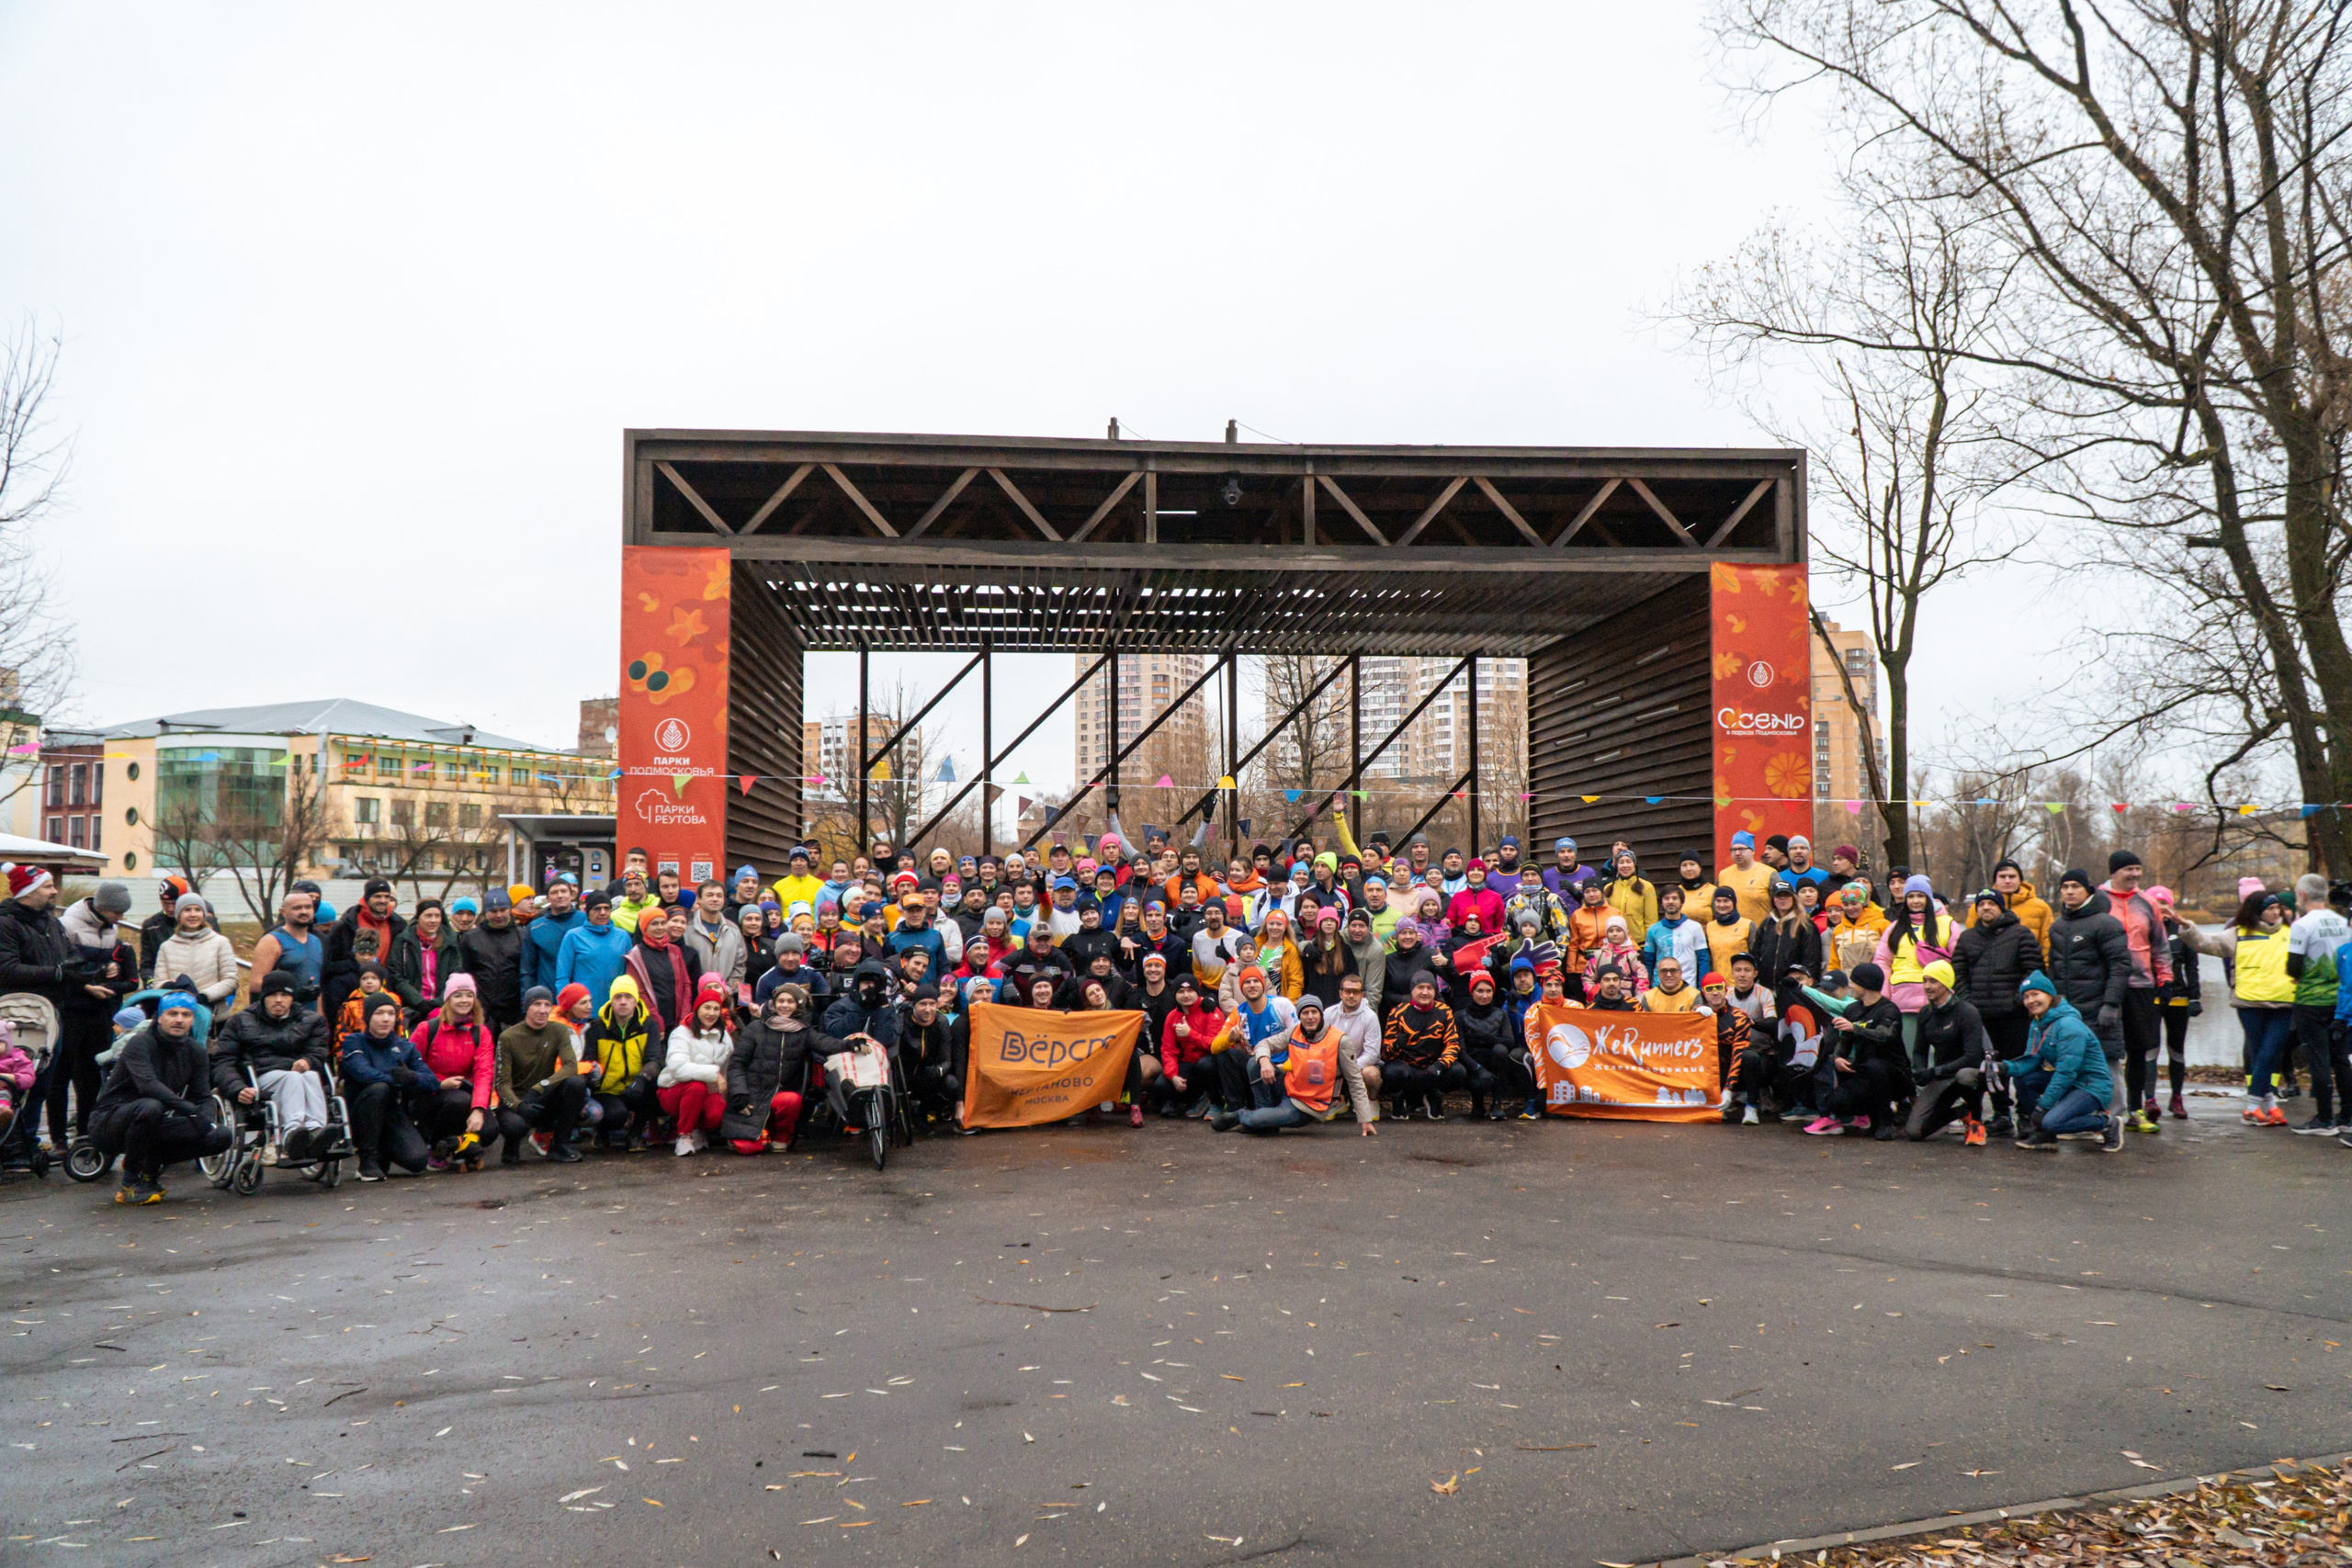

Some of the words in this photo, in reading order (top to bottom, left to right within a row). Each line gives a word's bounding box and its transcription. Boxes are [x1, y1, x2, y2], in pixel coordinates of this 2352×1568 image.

[653, 757, 690, 765] ПАРКИ
[629, 766, 714, 776] ПОДМОСКОВЬЯ
[654, 805, 695, 815] ПАРКИ
[654, 815, 707, 825] РЕУТОВА
[1592, 1024, 1703, 1066] ЖеRunners
[1594, 1064, 1704, 1074] Железнодорожный
[1024, 1094, 1069, 1105] МОСКВА
